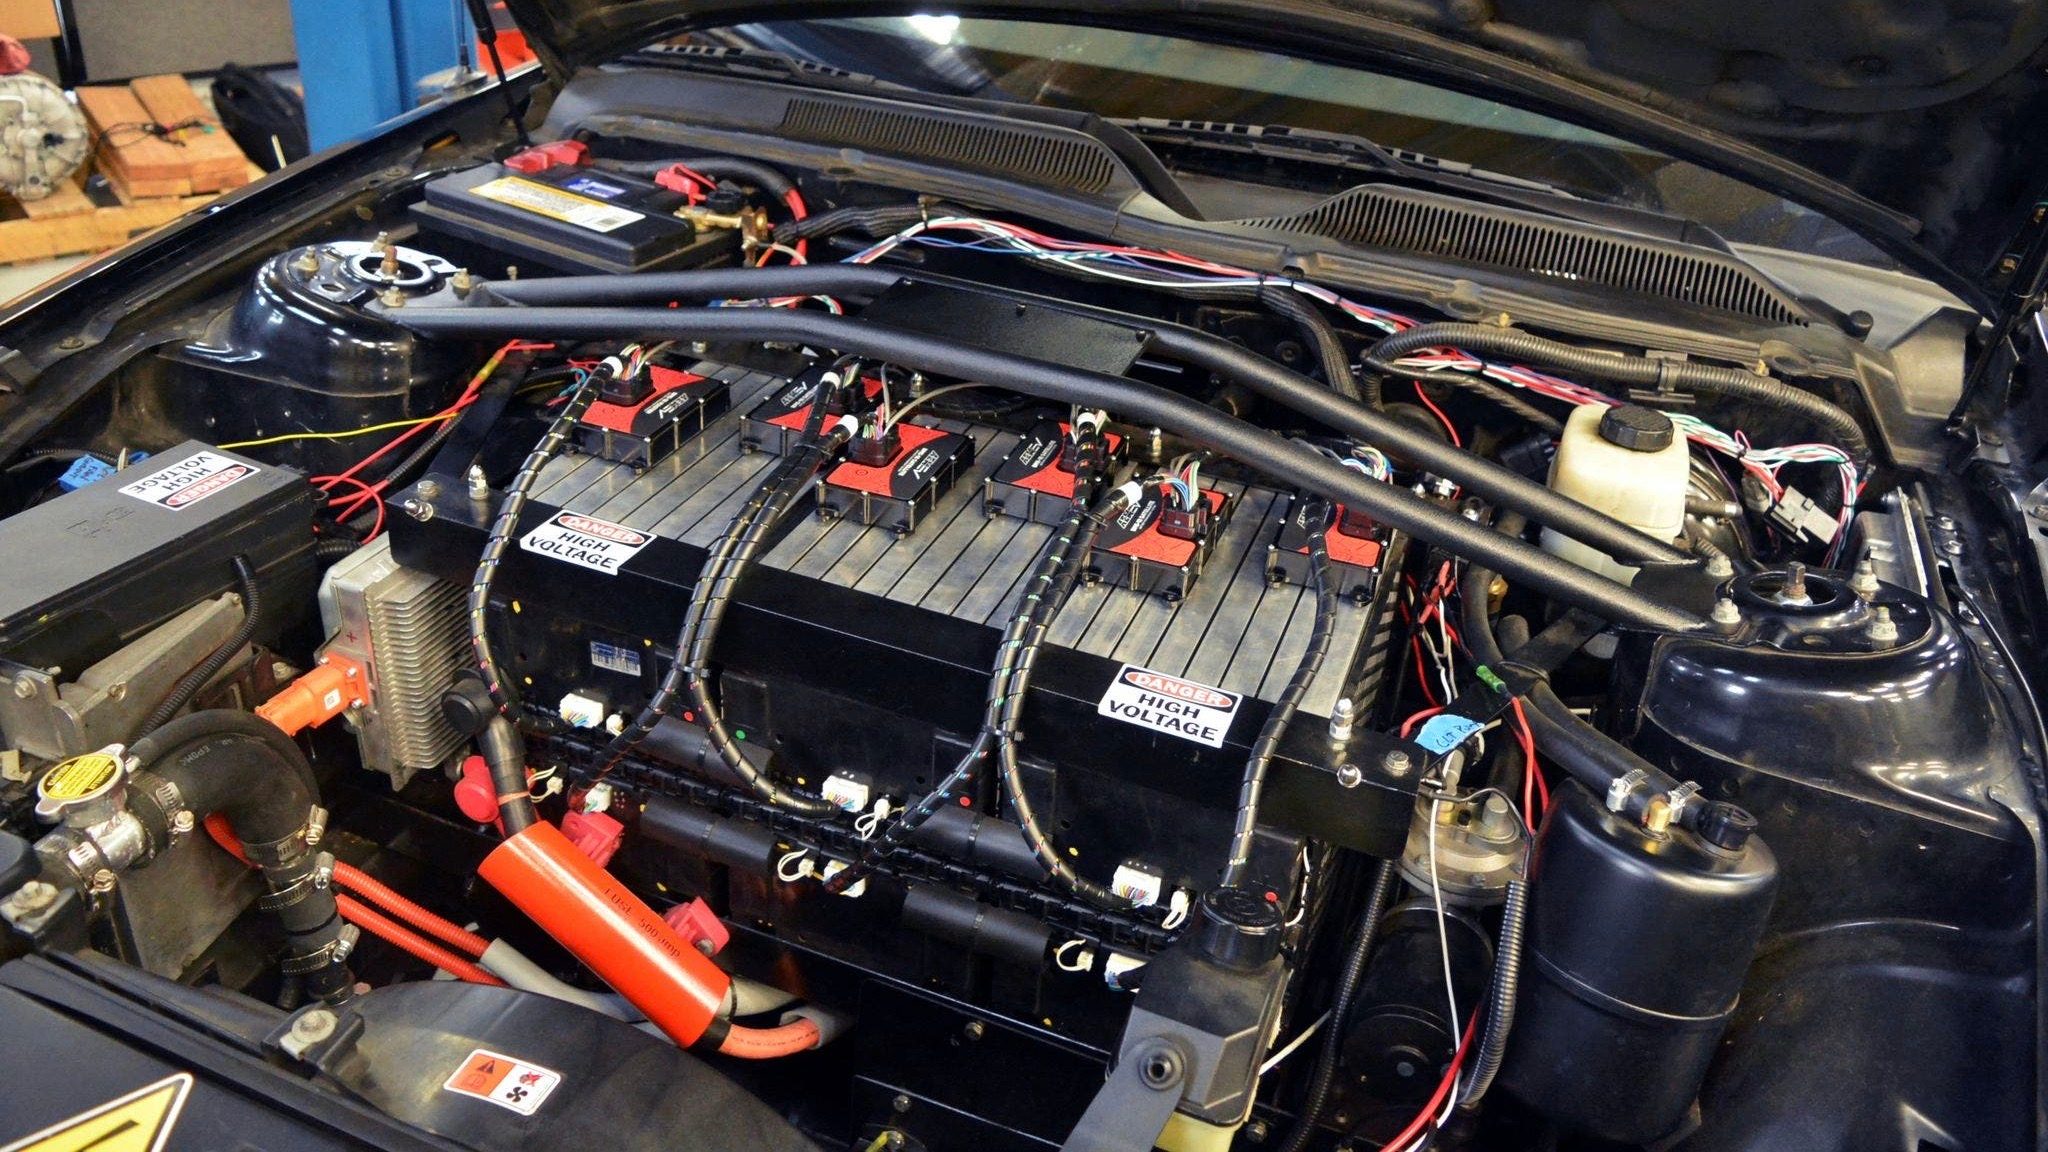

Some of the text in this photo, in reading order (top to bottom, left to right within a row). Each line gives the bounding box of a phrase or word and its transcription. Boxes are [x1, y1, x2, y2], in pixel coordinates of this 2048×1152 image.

[128, 455, 213, 494] VOLTAGE
[162, 468, 212, 491] HIGH
[176, 469, 238, 502] DANGER
[558, 532, 611, 552] HIGH
[568, 519, 638, 543] DANGER
[528, 536, 618, 568] VOLTAGE
[1134, 674, 1221, 706] DANGER
[1138, 693, 1200, 719] HIGH
[1110, 699, 1219, 741] VOLTAGE
